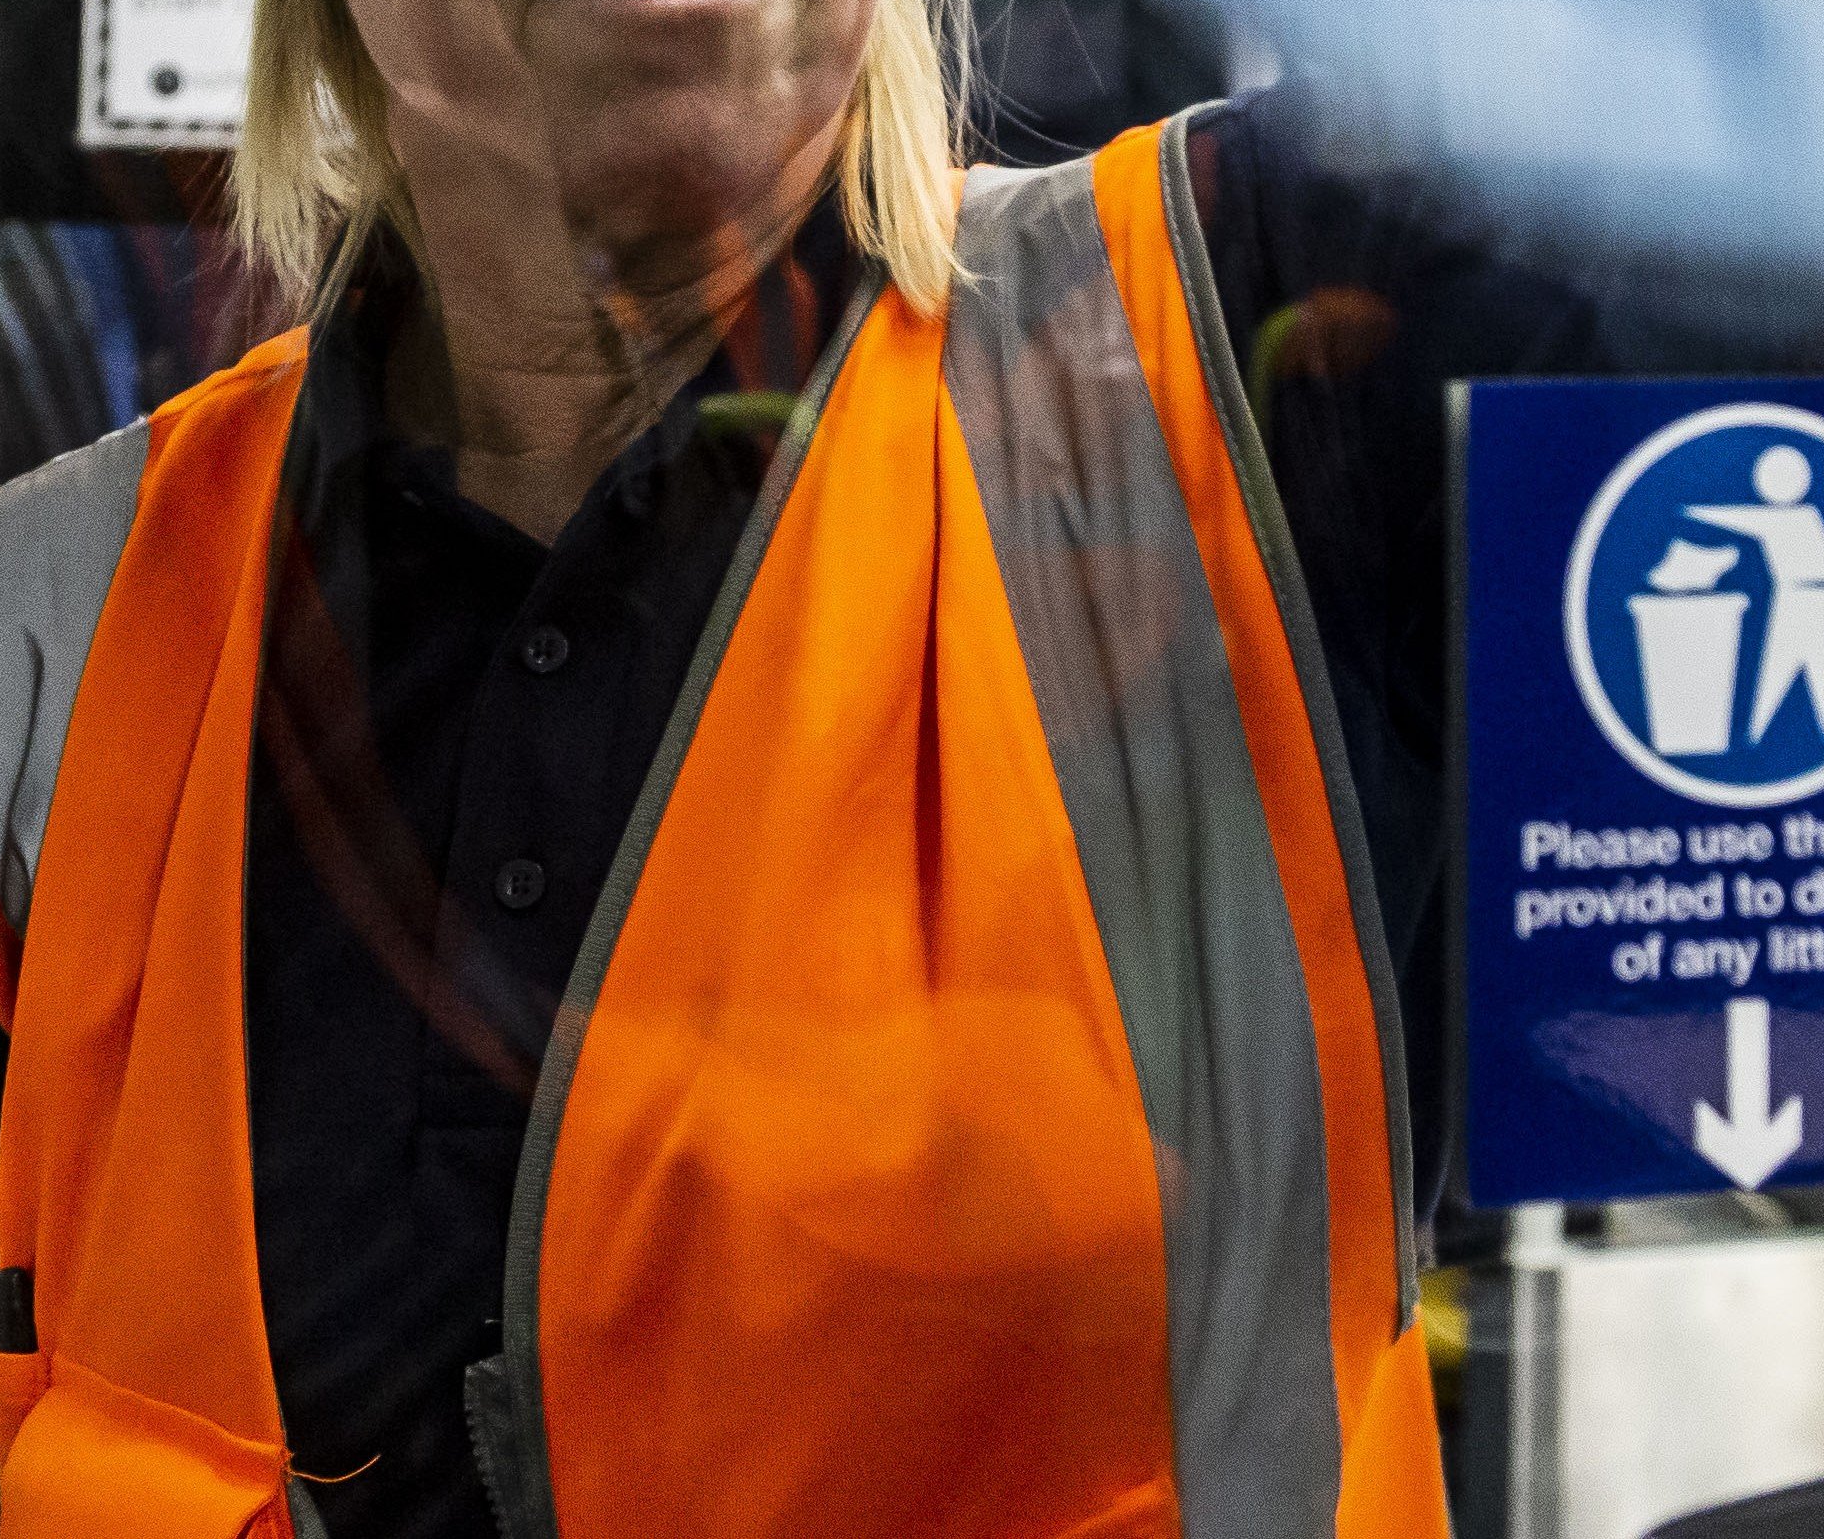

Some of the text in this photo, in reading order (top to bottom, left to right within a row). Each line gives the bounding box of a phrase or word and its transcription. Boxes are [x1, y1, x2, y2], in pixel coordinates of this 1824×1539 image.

[1521, 821, 1681, 870] Please
[1688, 824, 1774, 862] use
[1515, 873, 1724, 938] provided
[1734, 873, 1785, 917] to
[1612, 932, 1665, 982] of
[1672, 938, 1759, 986] any
